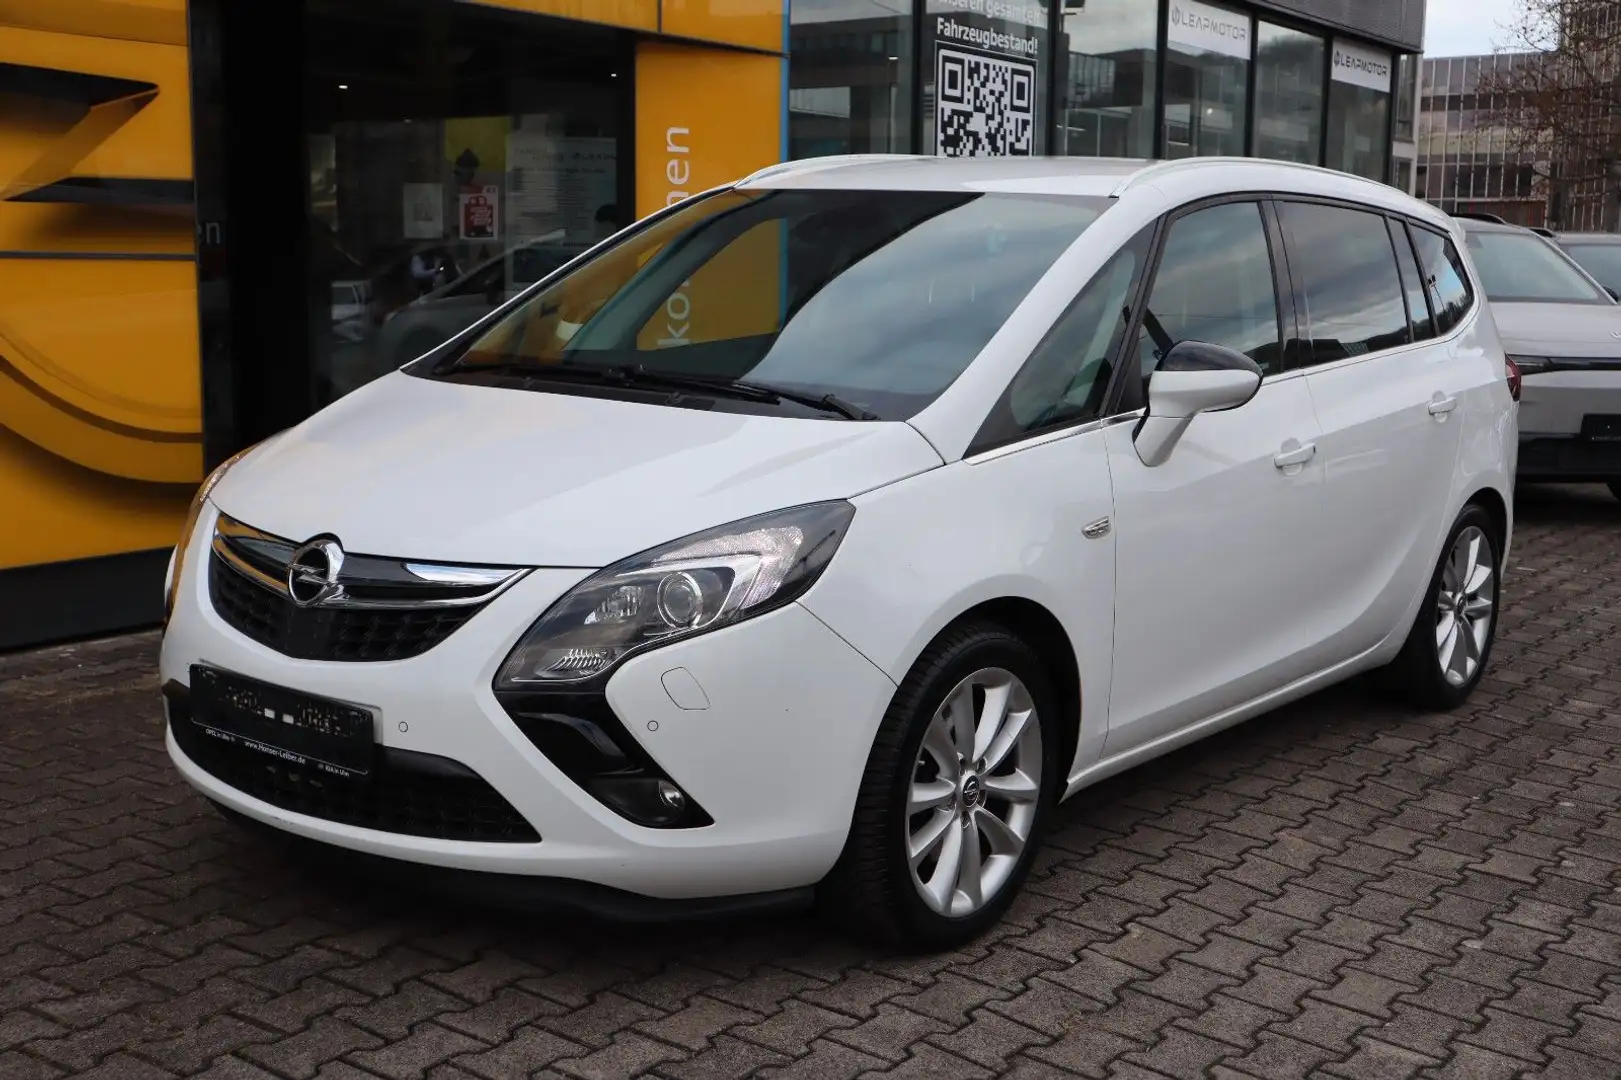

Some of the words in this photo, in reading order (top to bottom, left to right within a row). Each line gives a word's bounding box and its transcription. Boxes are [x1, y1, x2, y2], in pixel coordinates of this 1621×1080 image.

[937, 17, 1038, 54] Fahrzeugbestand!
[1182, 12, 1247, 40] LEAPMOTOR
[1341, 54, 1388, 76] LEAPMOTOR
